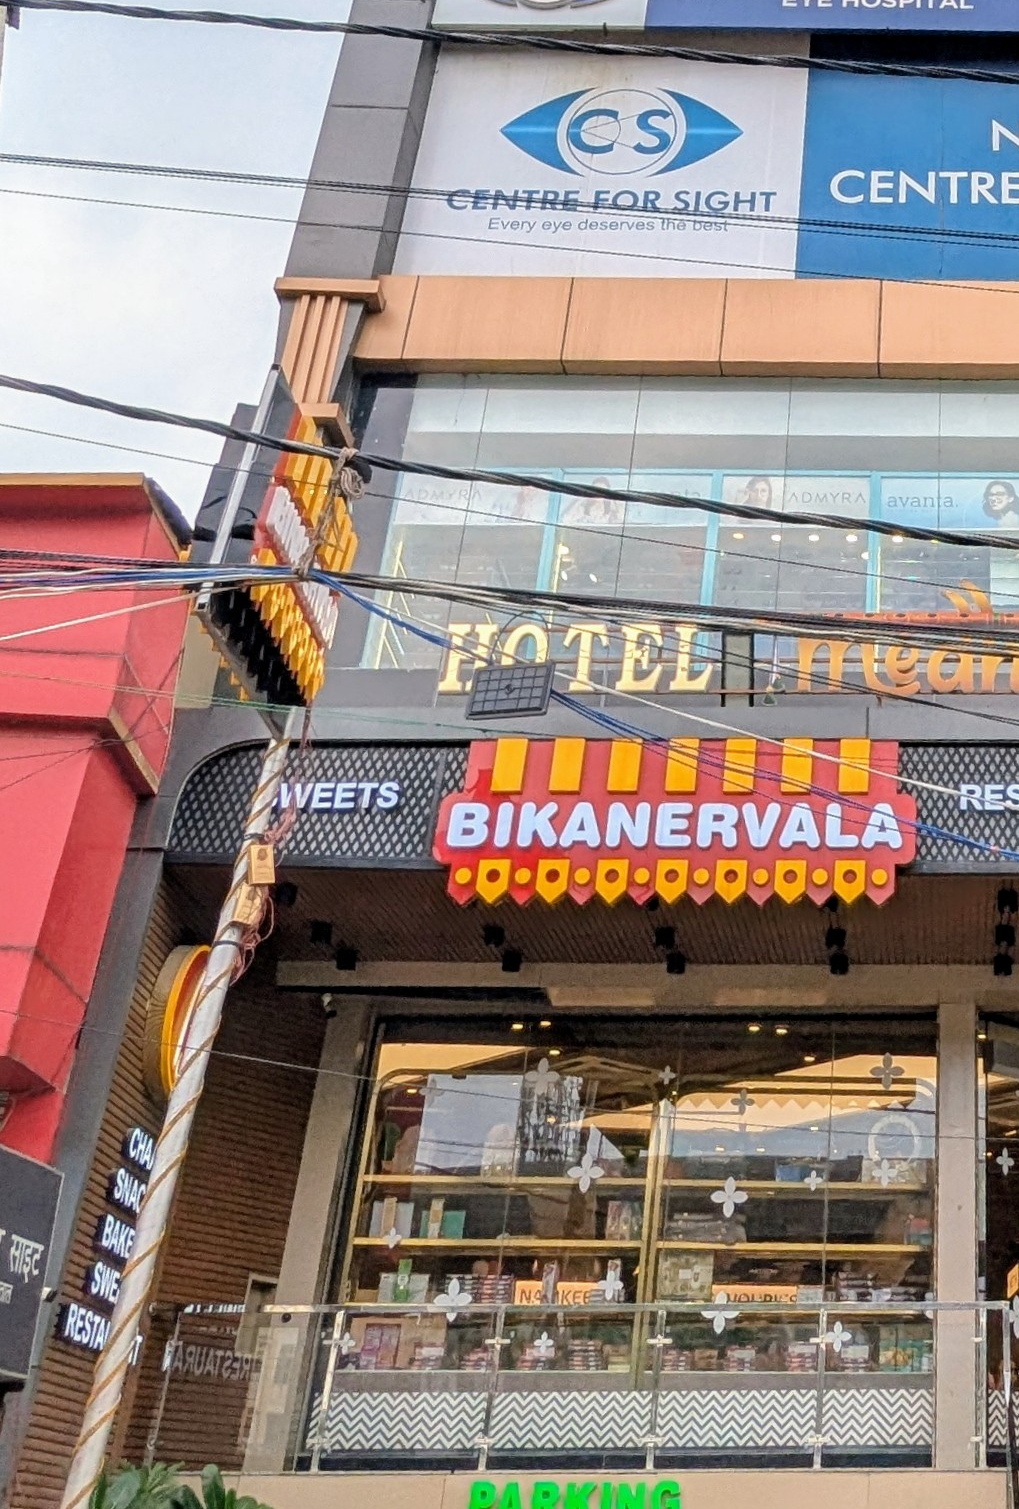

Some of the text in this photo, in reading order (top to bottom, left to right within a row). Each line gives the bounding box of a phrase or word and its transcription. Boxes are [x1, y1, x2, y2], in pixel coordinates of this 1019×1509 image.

[446, 188, 777, 213] CENTRE FOR SIGHT
[488, 217, 729, 233] Every eye deserves the best
[787, 491, 866, 505] ADMYRA
[438, 622, 714, 692] HOTEL
[272, 781, 400, 809] WEETS
[446, 800, 903, 850] BIKANERVALA
[129, 1127, 156, 1170] CHA
[114, 1167, 147, 1212] SNAC
[102, 1213, 136, 1259] BAKE
[91, 1261, 120, 1305] SWE
[469, 1479, 681, 1509] PARKING
